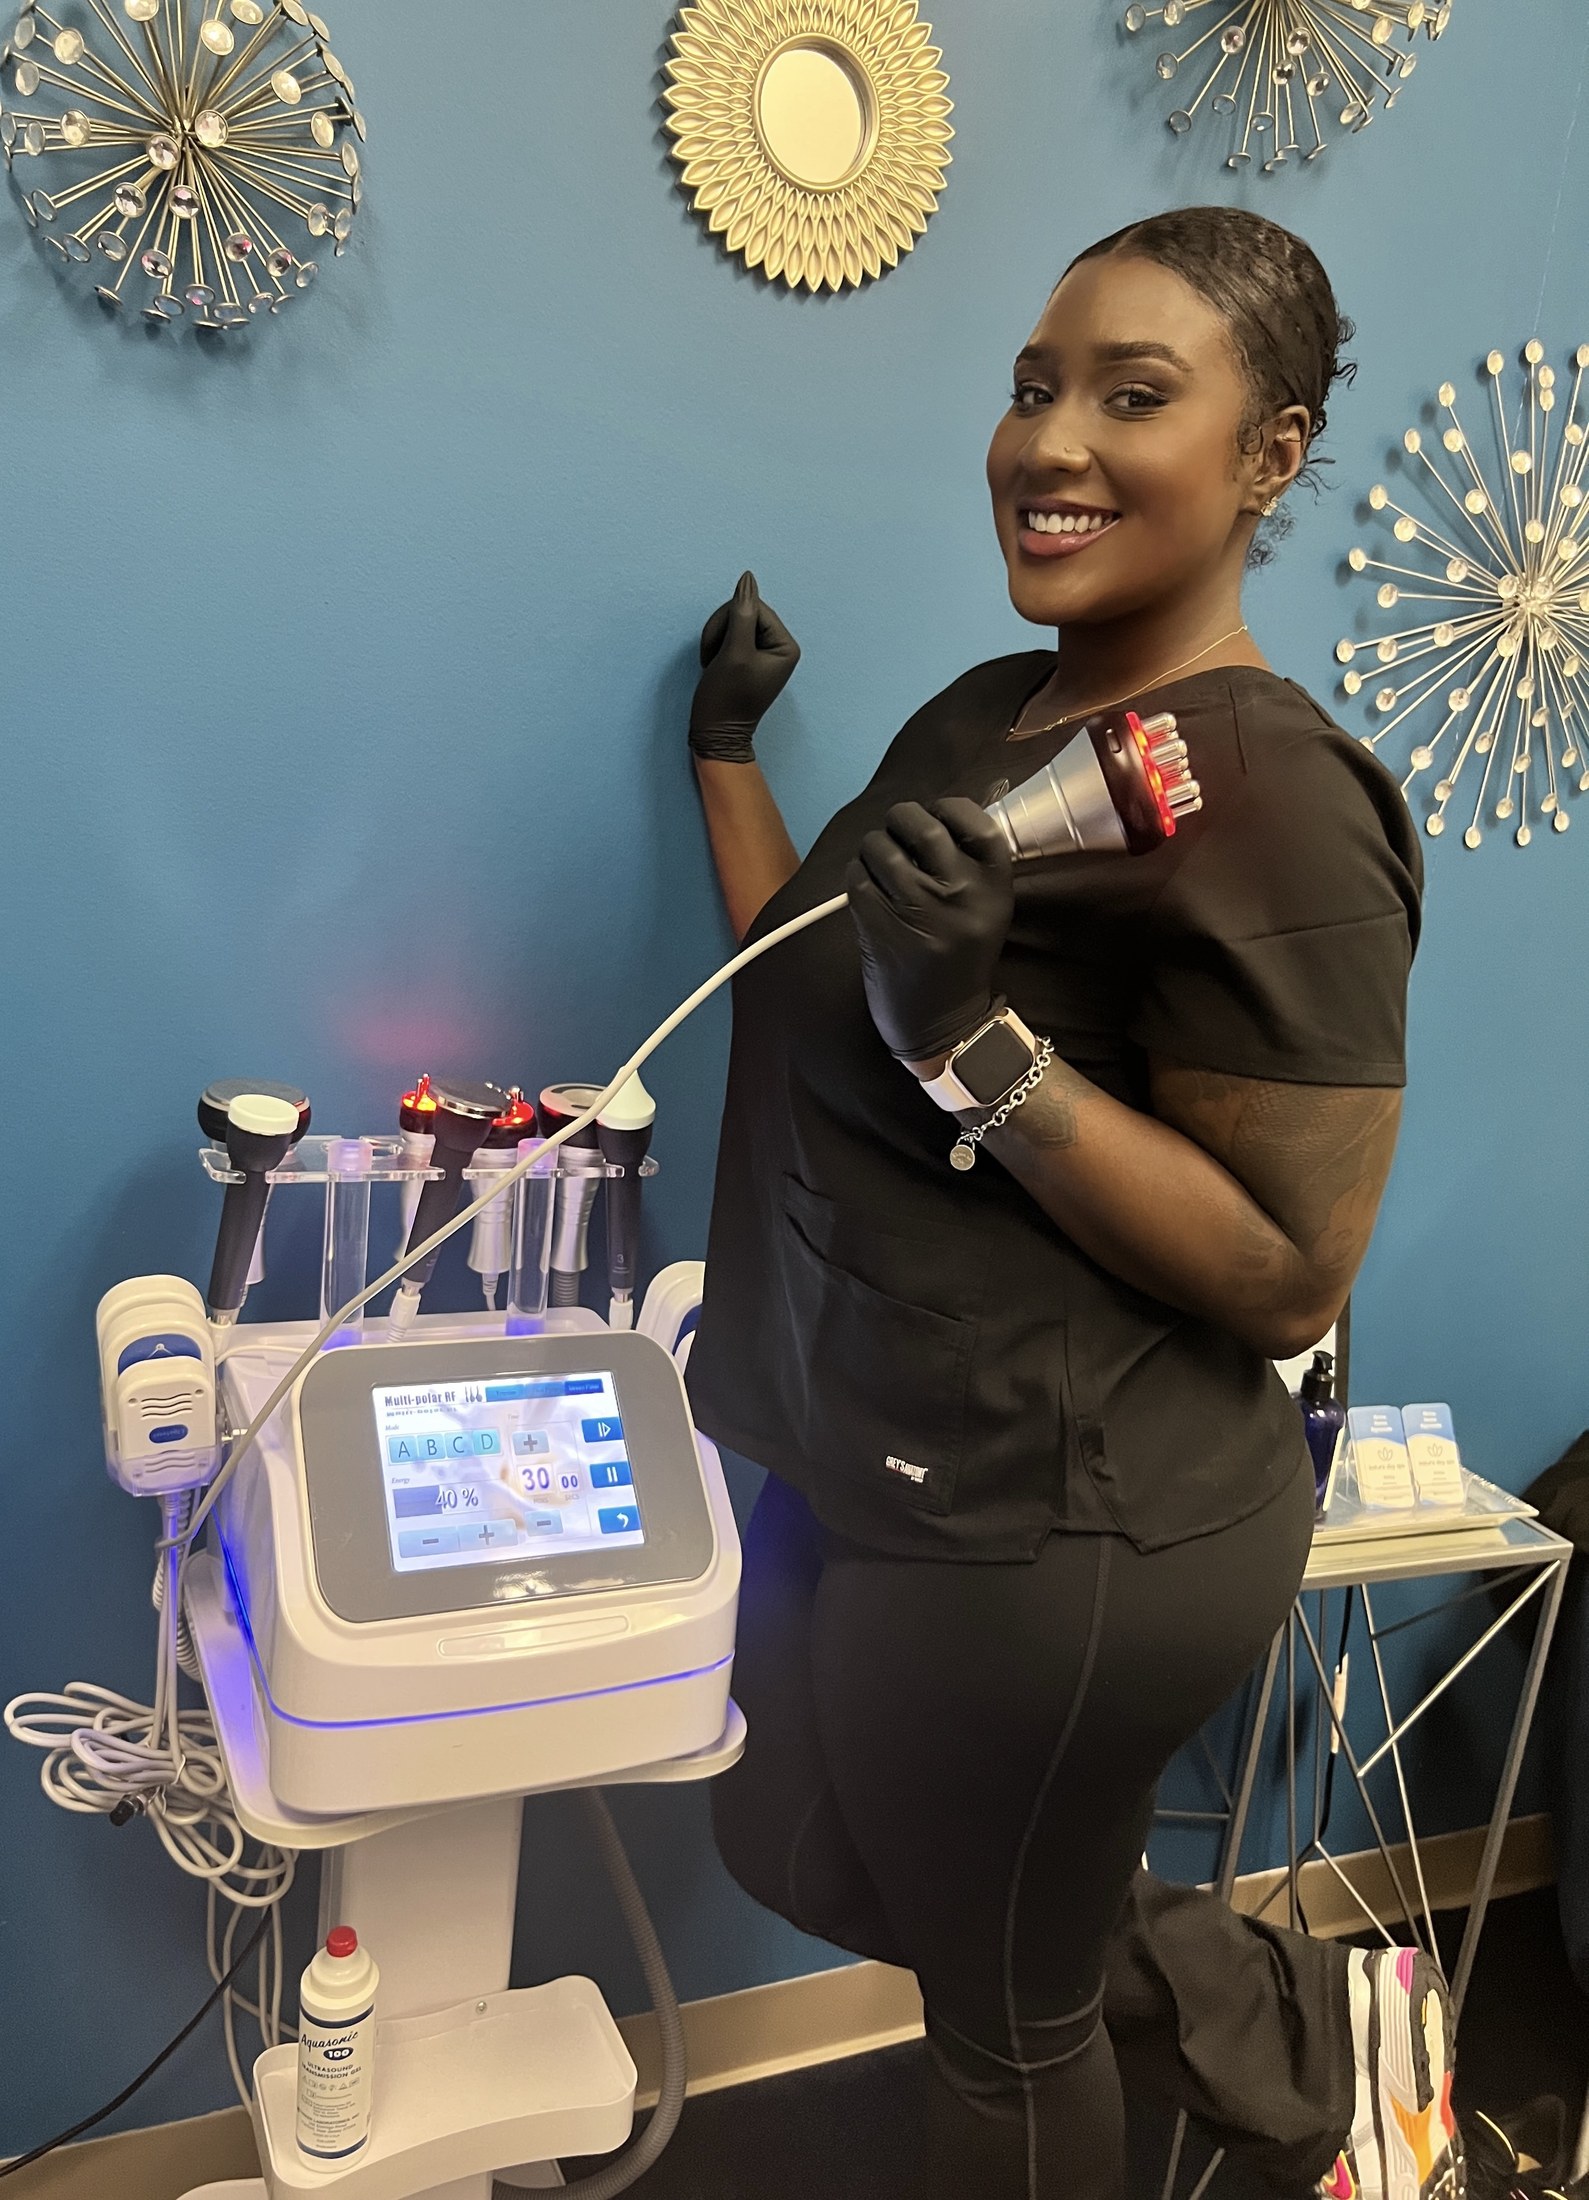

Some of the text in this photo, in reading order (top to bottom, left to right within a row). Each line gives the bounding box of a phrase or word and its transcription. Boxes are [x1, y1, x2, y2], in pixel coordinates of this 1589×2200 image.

[384, 1391, 456, 1407] Multi-polar RF
[398, 1433, 493, 1458] A B C D
[522, 1467, 578, 1491] 30 00
[300, 2031, 358, 2053] Aquasonic
[328, 2049, 350, 2058] 100
[307, 2061, 354, 2073] ULTRASOUND
